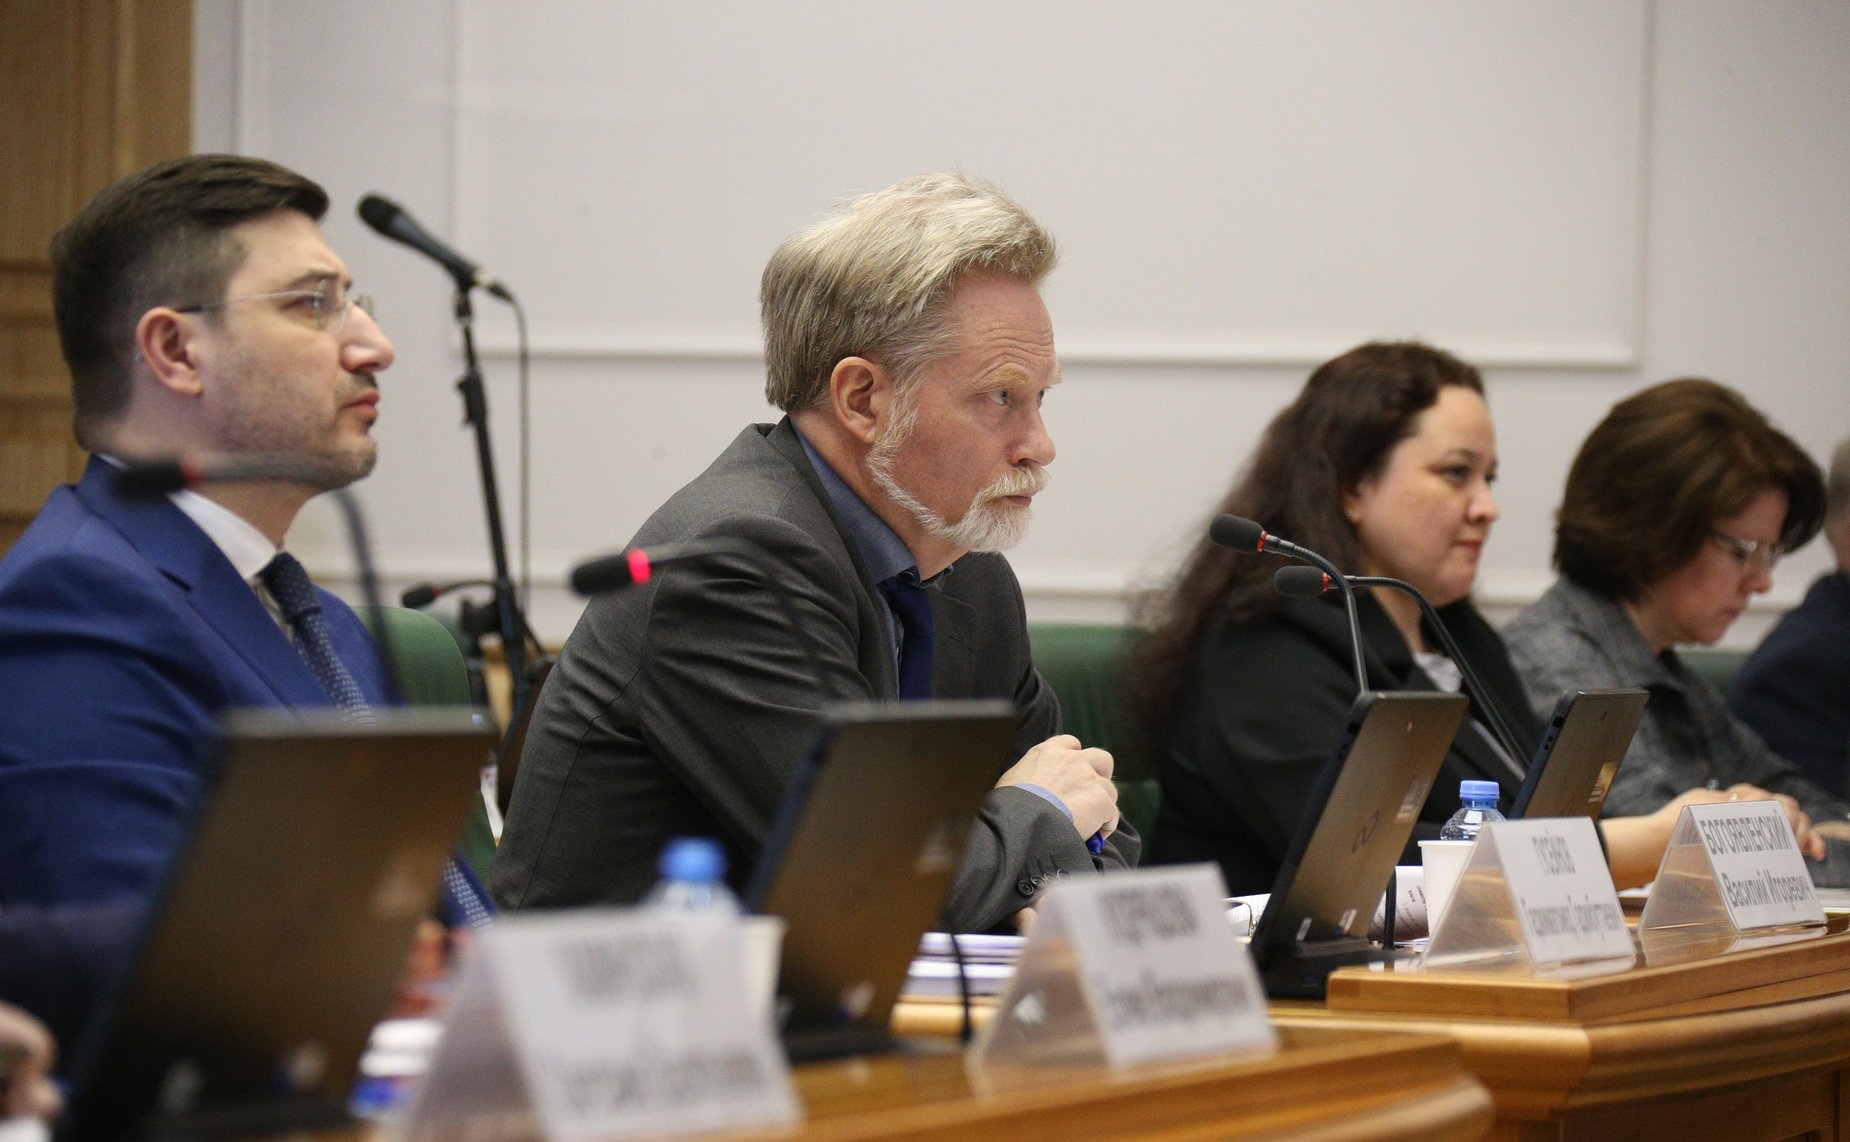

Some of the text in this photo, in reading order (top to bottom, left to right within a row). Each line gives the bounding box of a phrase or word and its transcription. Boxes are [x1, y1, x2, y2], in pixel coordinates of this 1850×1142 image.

[1699, 808, 1792, 855] БОГОЯВЛЕНСКИЙ
[1720, 869, 1814, 910] Василий Игоревич
